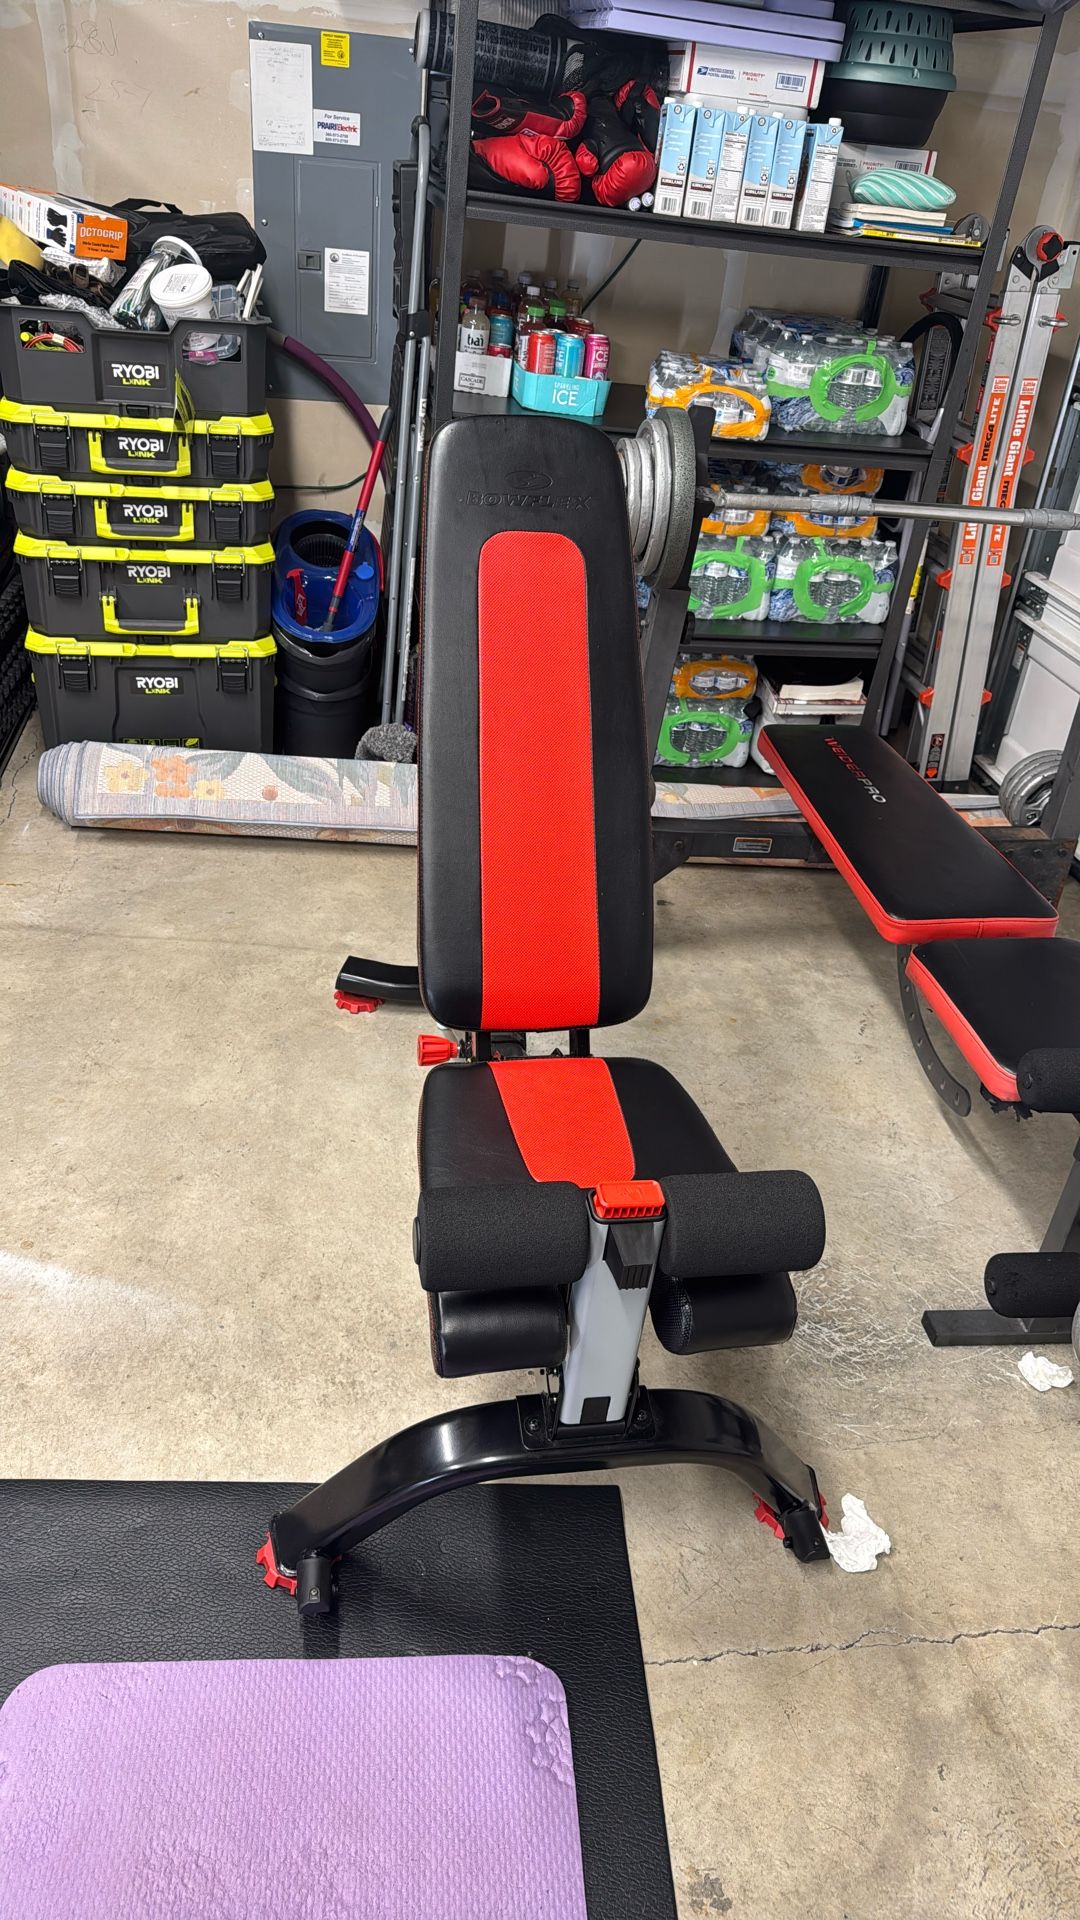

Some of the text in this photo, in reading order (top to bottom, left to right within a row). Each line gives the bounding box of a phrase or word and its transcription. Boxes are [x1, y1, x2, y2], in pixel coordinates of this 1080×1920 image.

[80, 226, 123, 241] OCTOGRIP
[592, 350, 608, 361] ICE
[111, 363, 160, 380] RYOBI
[554, 381, 580, 390] SPARKLING
[552, 389, 578, 406] ICE
[1012, 400, 1031, 437] Little
[117, 436, 164, 452] RYOBI
[971, 465, 989, 501] Giant
[981, 397, 1001, 462] MEGALITE
[1003, 440, 1021, 477] Giant
[466, 490, 592, 511] BOWFLEX
[122, 503, 168, 518] RYOBI
[126, 565, 171, 578] RYOBI
[135, 676, 179, 689] RYOBI
